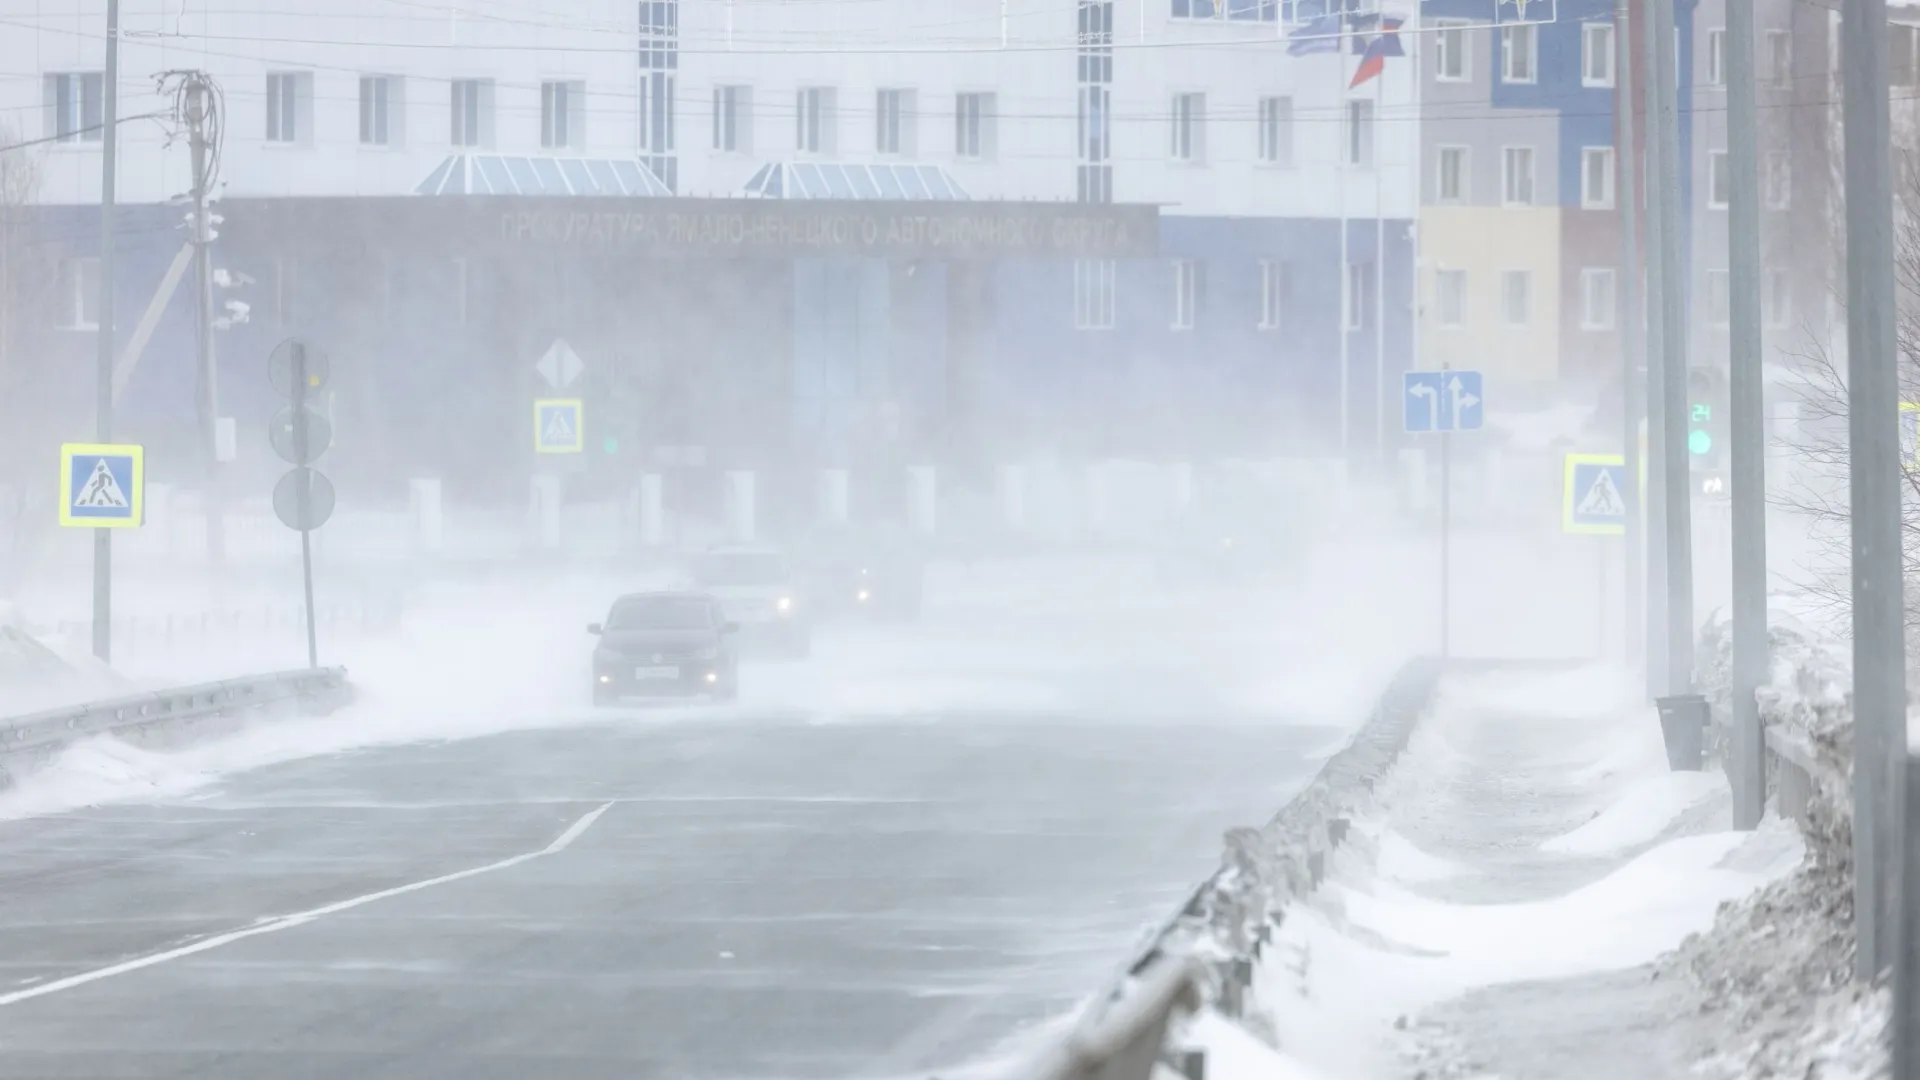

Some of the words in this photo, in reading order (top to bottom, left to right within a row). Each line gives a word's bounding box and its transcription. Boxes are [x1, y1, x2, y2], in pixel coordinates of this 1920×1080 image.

[501, 212, 659, 243] ПРОКУРАТУРА
[666, 213, 877, 249] ЯМАЛО-НЕНЕЦКОГО
[885, 216, 1043, 247] АВТОНОМНОГО
[1052, 217, 1129, 248] ОКРУГА
